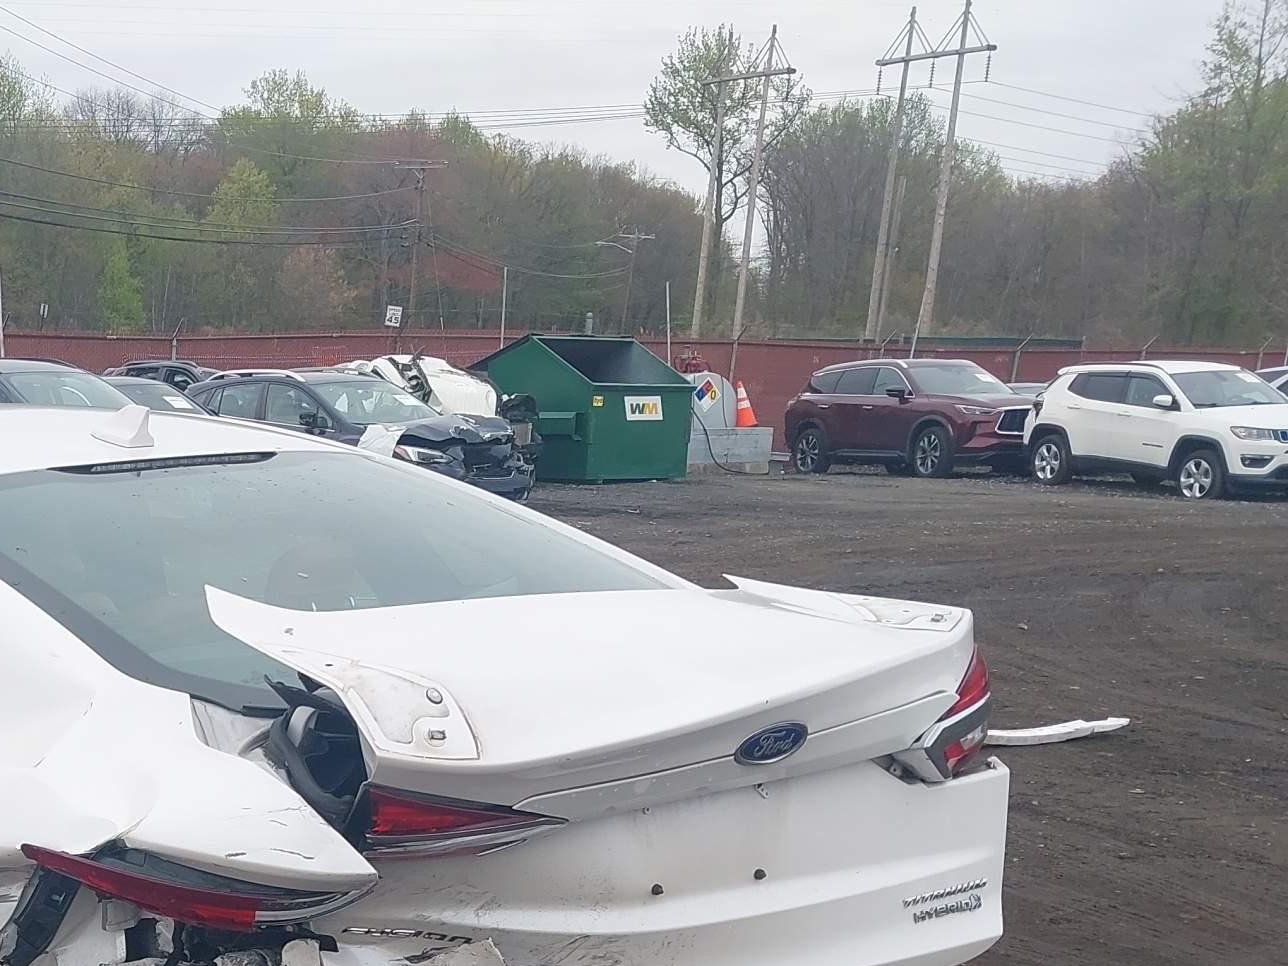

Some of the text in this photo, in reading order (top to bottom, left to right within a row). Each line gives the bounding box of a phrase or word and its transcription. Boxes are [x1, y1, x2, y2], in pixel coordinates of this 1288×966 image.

[386, 316, 399, 324] 45
[710, 390, 716, 400] 0
[630, 403, 658, 415] WM
[753, 731, 795, 757] Ford
[902, 879, 988, 908] TITANIUM
[913, 900, 972, 924] HYBRID
[342, 926, 473, 944] FUSION
